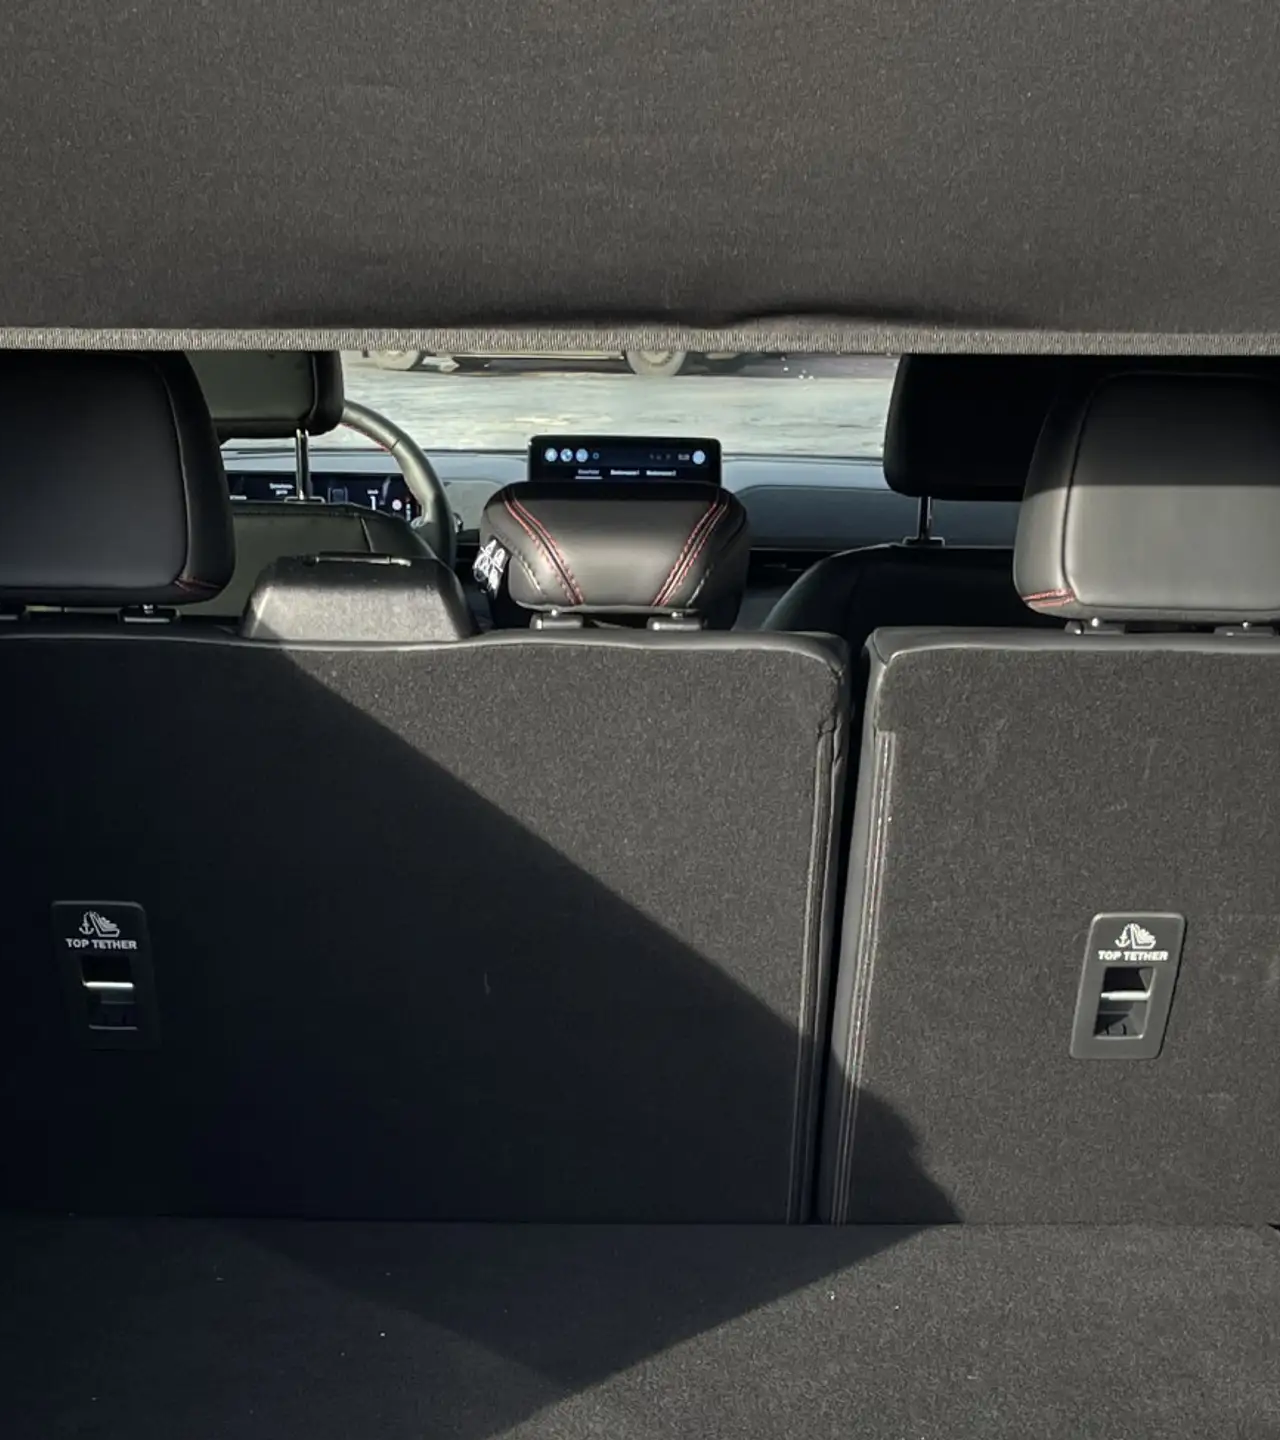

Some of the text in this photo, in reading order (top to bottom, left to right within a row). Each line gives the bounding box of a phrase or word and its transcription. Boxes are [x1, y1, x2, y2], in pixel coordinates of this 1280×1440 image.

[65, 938, 137, 949] TOP TETHER
[1097, 950, 1169, 961] TOP TETHER
